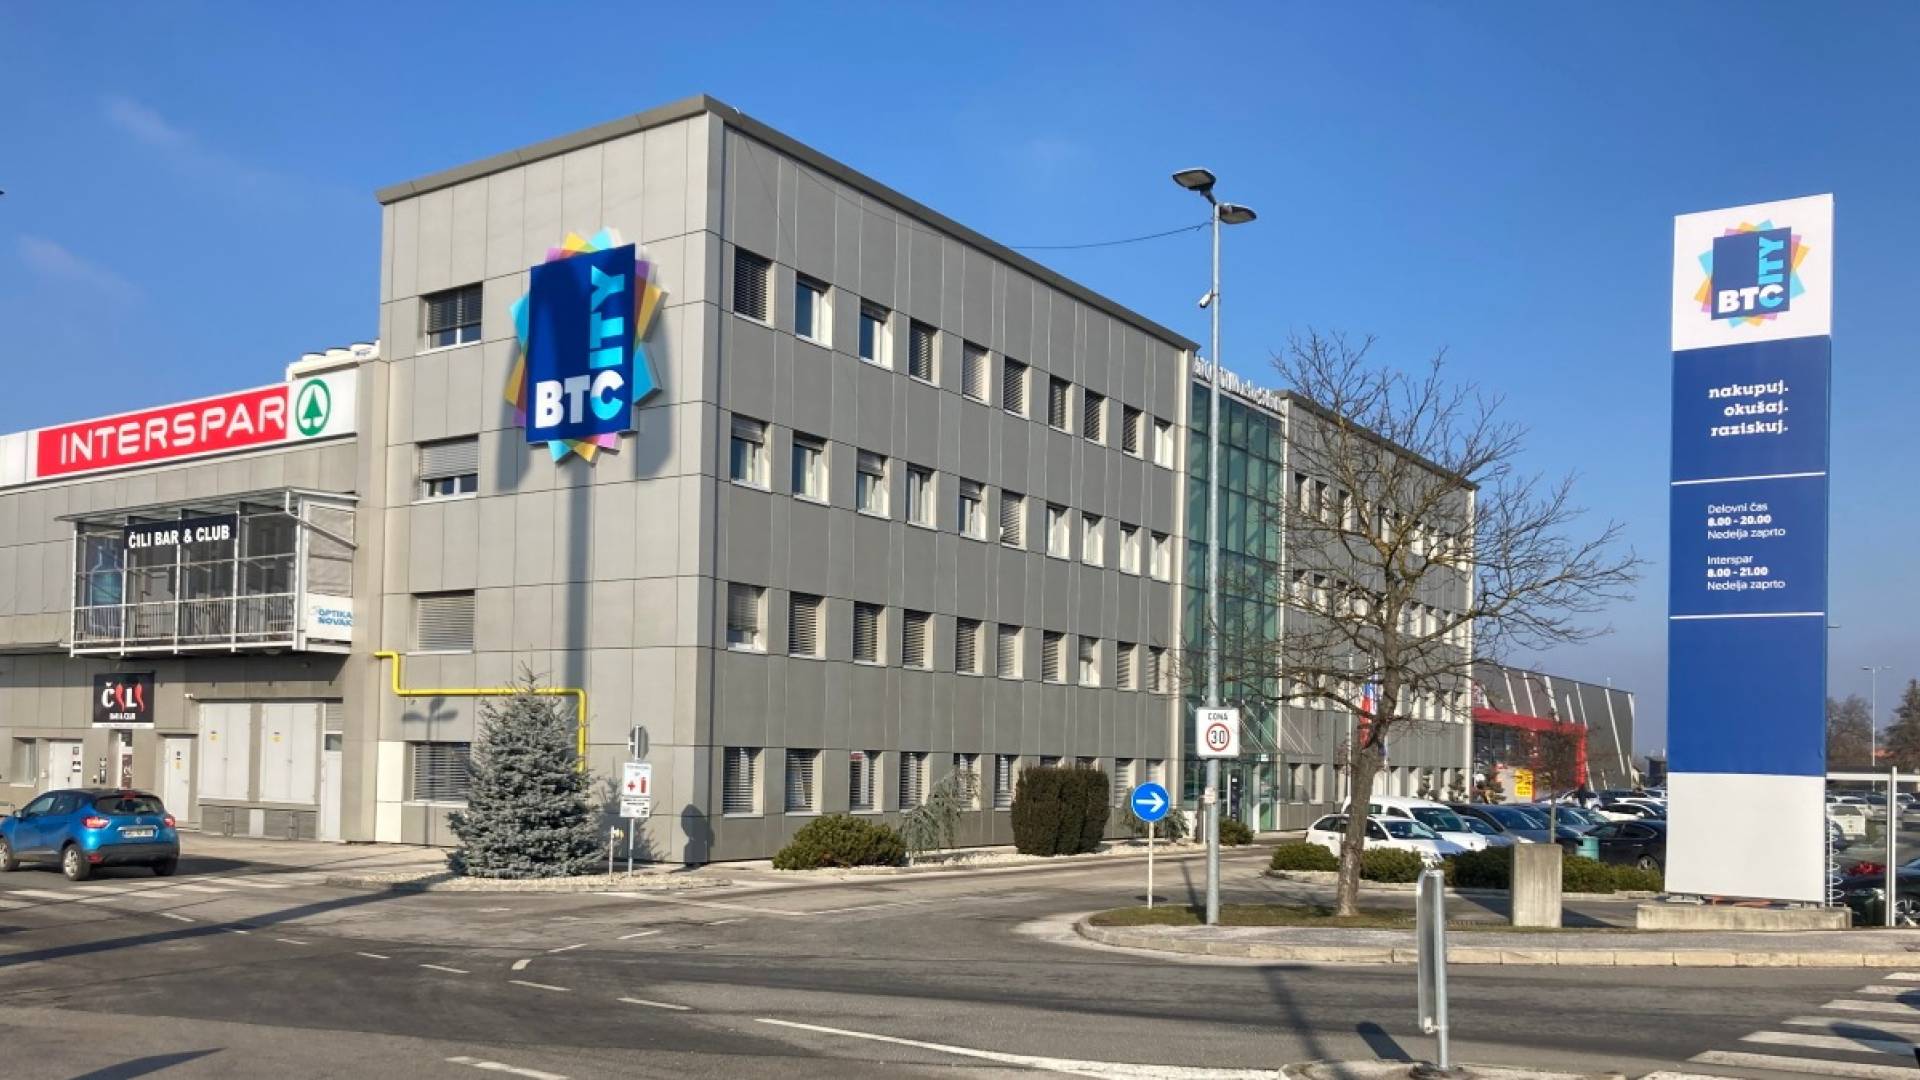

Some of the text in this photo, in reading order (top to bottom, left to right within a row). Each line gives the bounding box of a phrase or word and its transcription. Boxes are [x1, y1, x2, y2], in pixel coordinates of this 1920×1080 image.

[1718, 284, 1784, 314] BTC
[1708, 379, 1789, 399] nakupuj.
[535, 369, 625, 429] BTC
[1723, 399, 1789, 416] okušaj.
[61, 395, 286, 464] INTERSPAR
[1710, 419, 1789, 437] raziskuj.
[1707, 502, 1768, 514] Delovni čas
[1707, 516, 1732, 527] 8.00
[1739, 514, 1772, 525] 20.00
[128, 524, 231, 549] ČILI BAR & CLUB
[1707, 528, 1786, 540] Nedelja zaprto
[1707, 555, 1754, 566] Interspar
[1707, 568, 1731, 578] 8.00
[1739, 566, 1768, 577] 21.00
[1707, 579, 1786, 591] Nedelja zaprto
[318, 608, 353, 619] OPTIKA
[1211, 730, 1225, 744] 30
